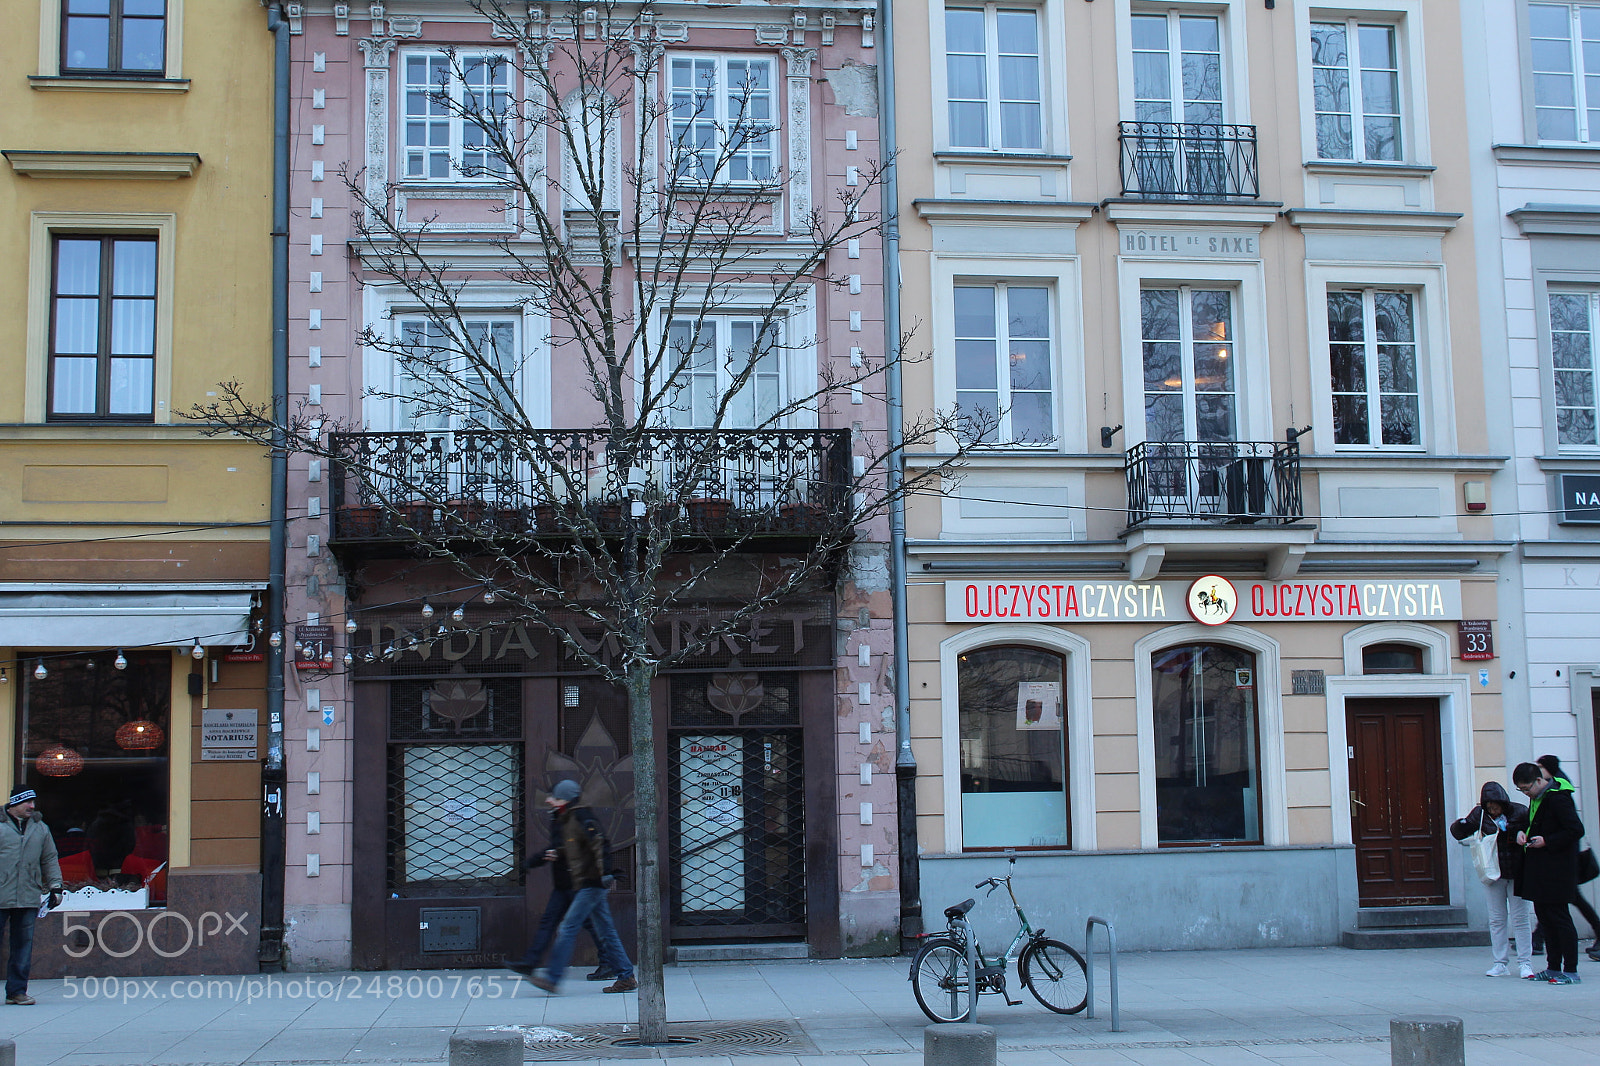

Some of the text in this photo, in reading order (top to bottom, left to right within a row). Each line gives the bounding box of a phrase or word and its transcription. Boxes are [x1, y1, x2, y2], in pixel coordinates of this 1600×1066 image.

[1126, 230, 1254, 253] HÔTEL DE SAXE
[369, 619, 541, 662] INDIA
[1466, 633, 1487, 652] 33
